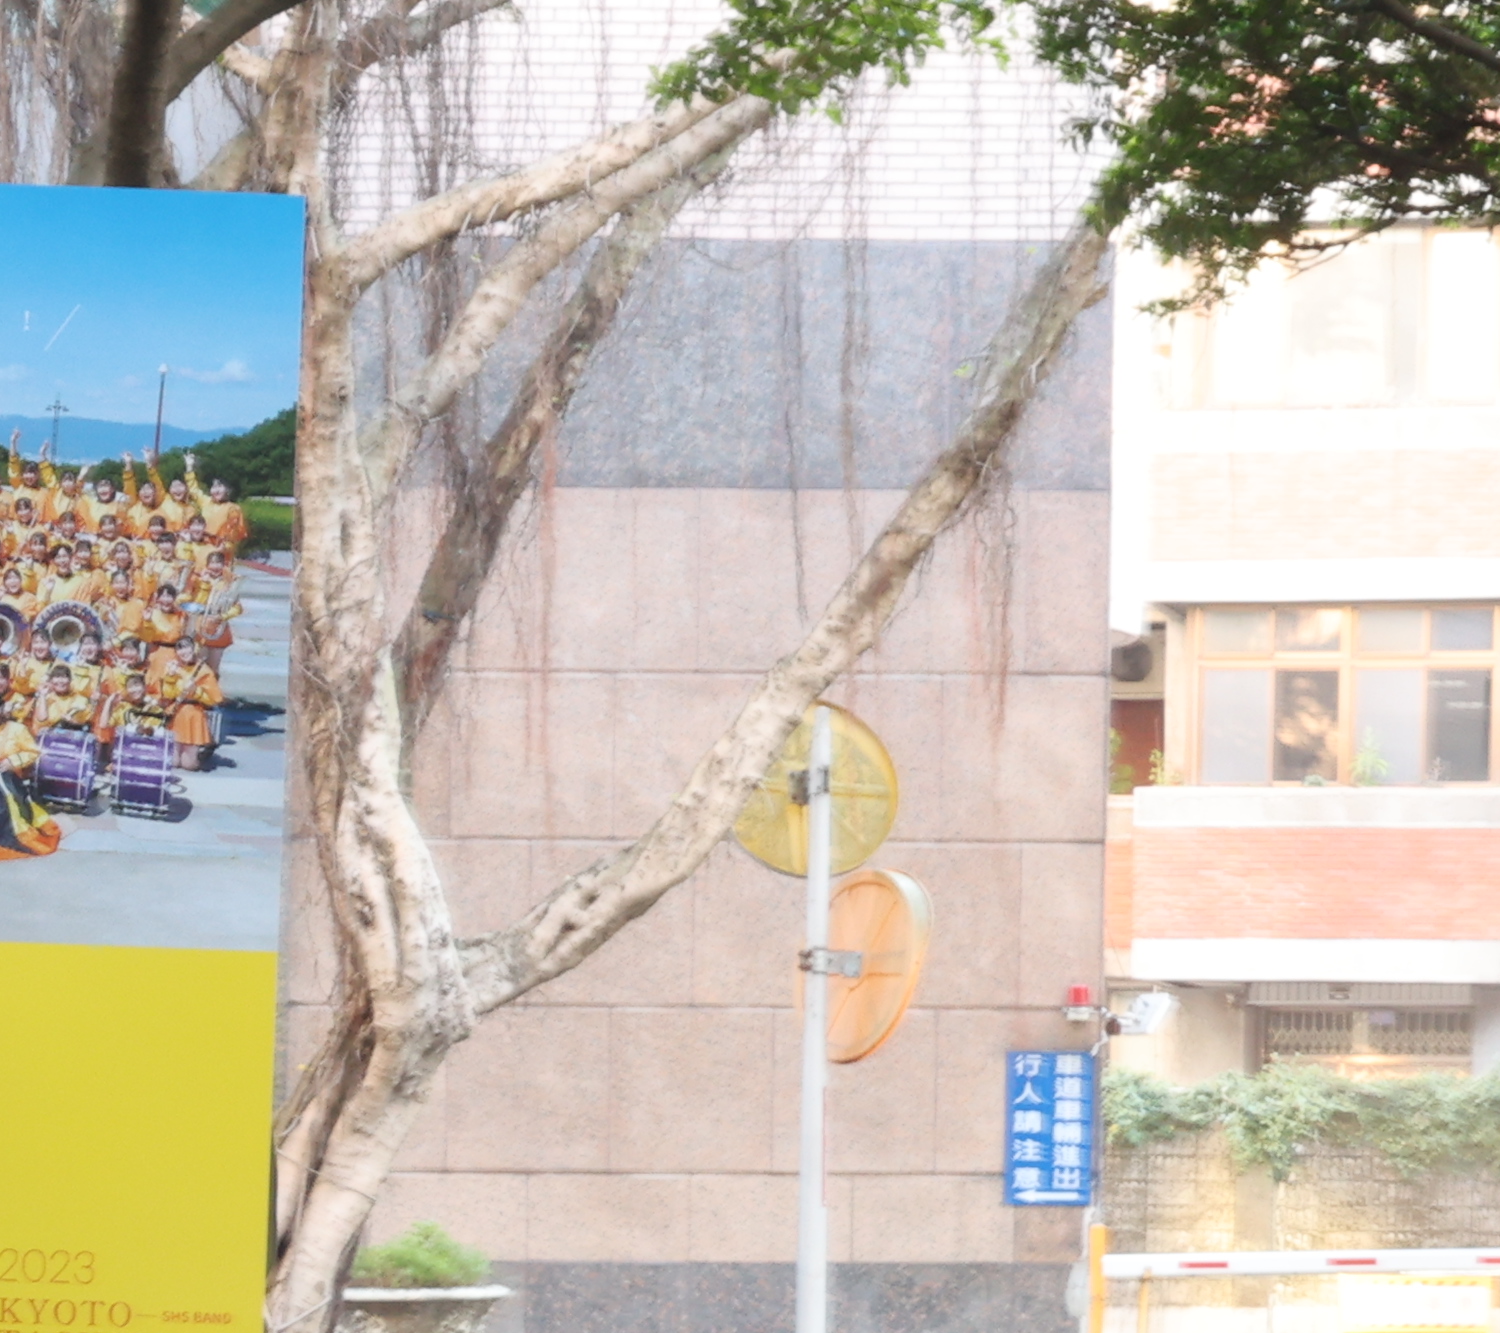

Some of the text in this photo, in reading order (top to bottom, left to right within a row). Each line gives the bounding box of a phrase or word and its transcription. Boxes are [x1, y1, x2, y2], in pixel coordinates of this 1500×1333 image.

[1012, 1053, 1044, 1188] 行人請注意
[162, 1311, 189, 1323] SHS
[193, 1311, 232, 1325] BAND
